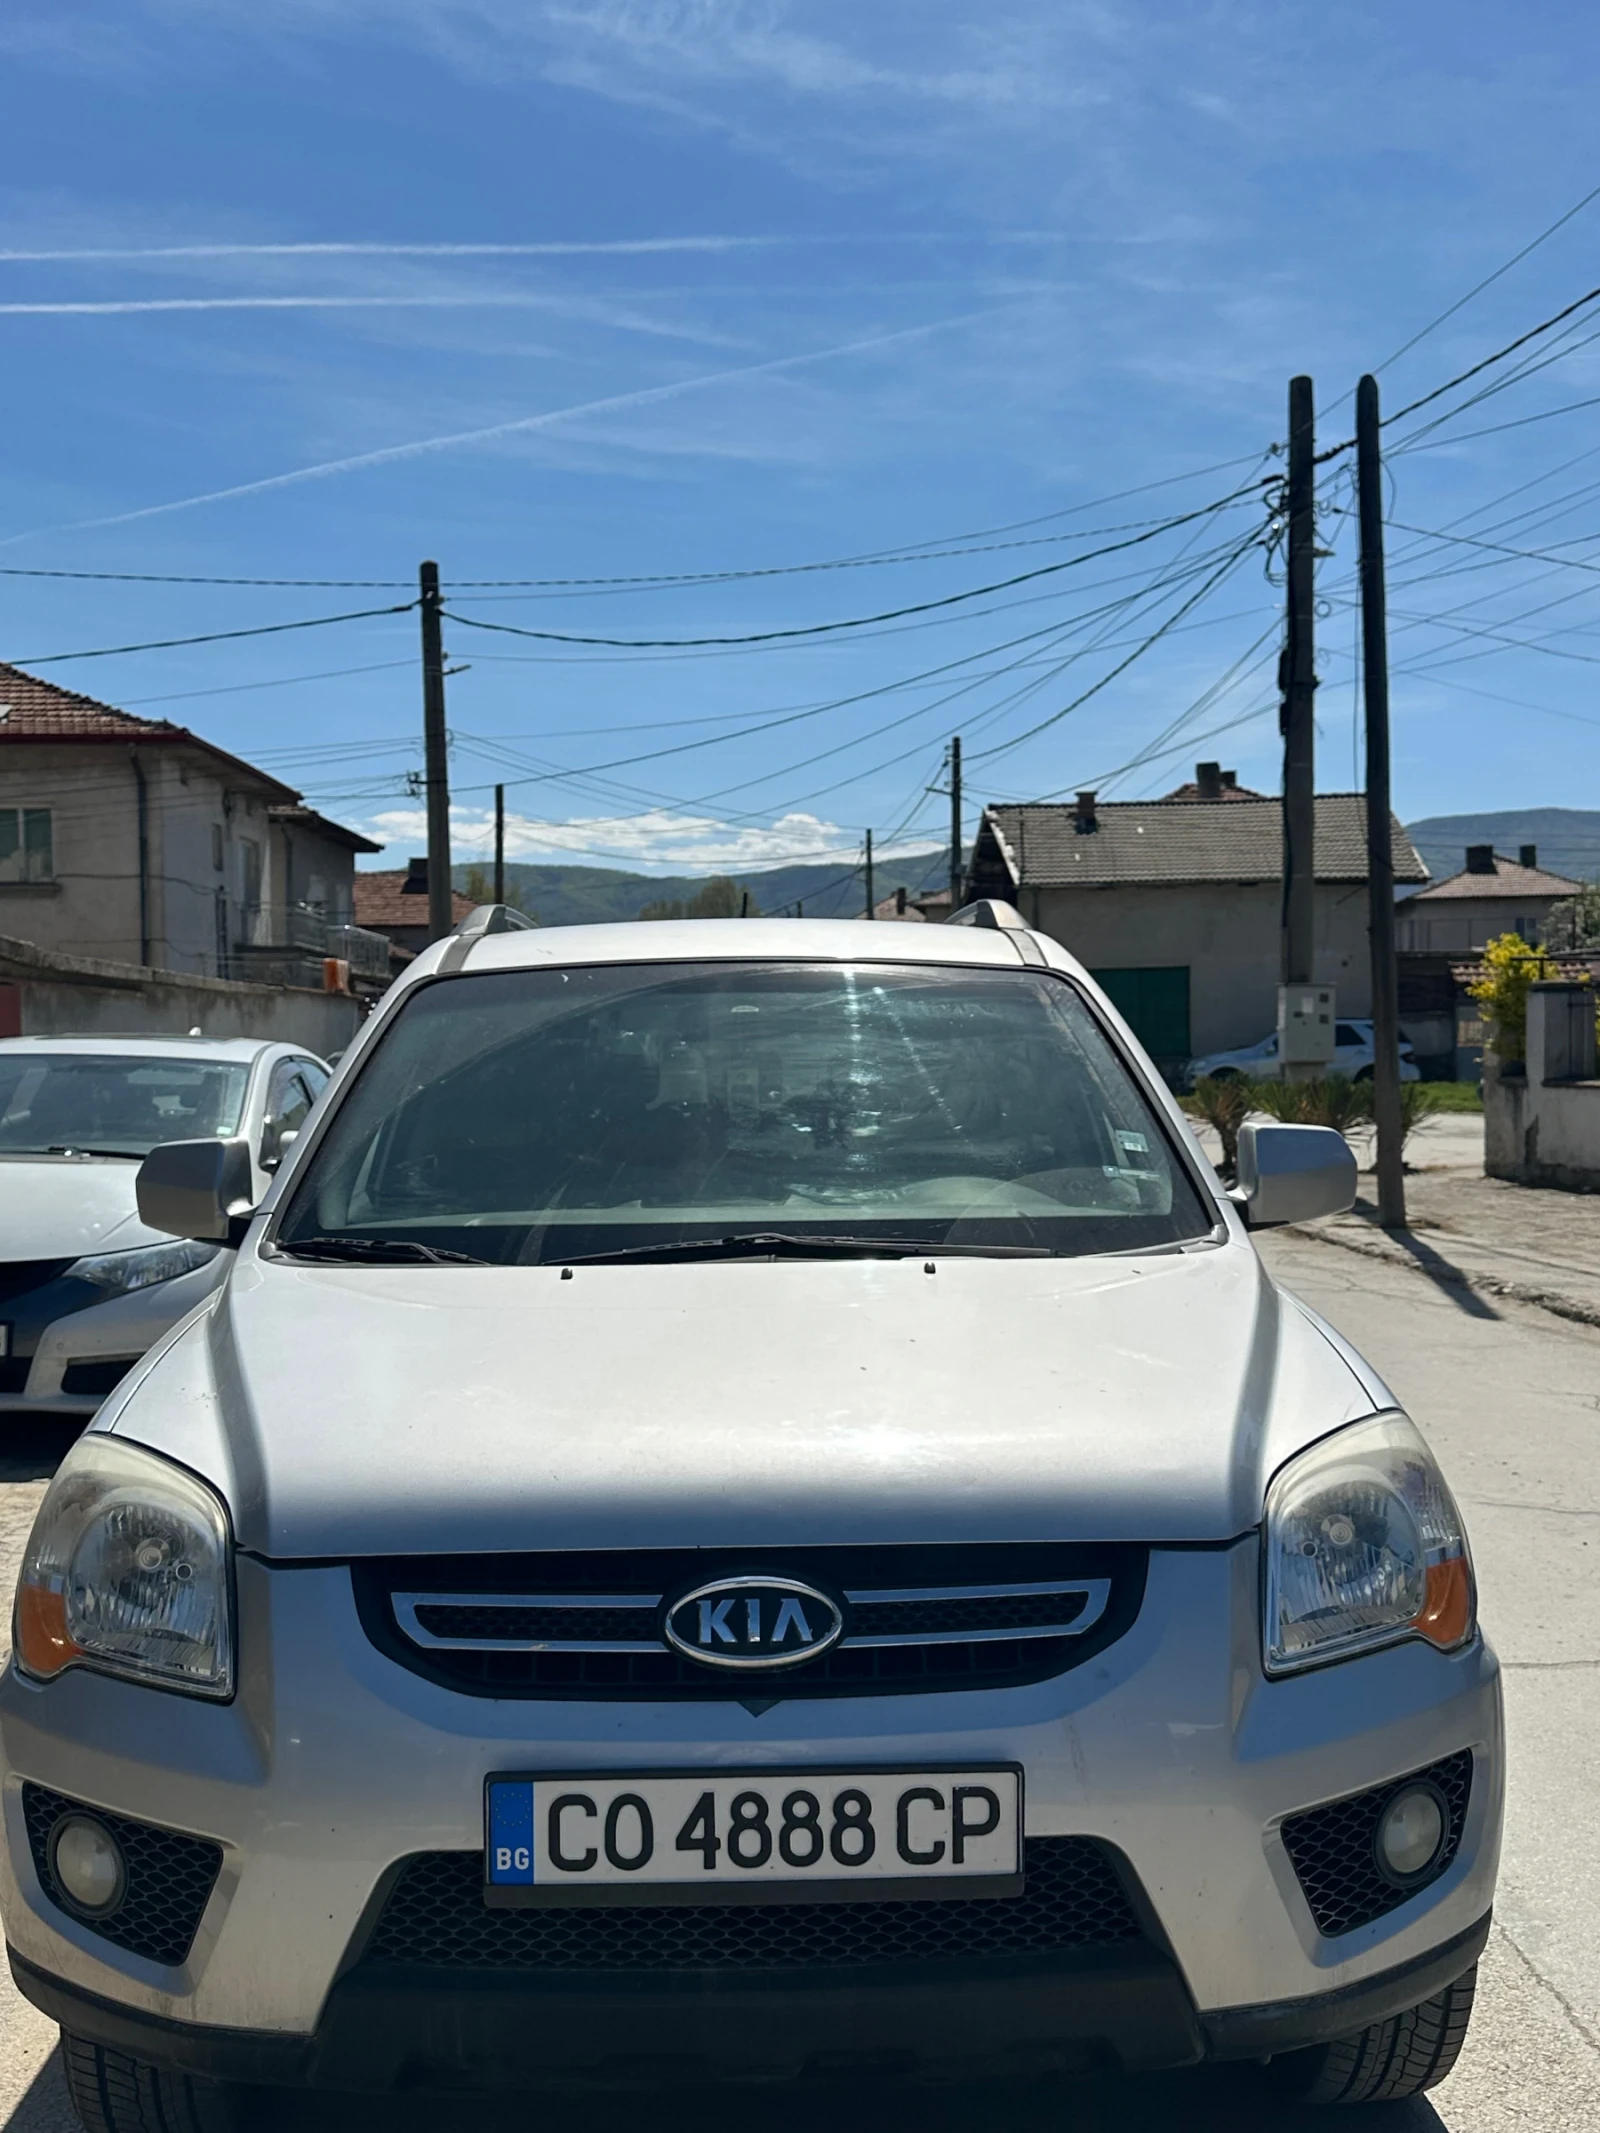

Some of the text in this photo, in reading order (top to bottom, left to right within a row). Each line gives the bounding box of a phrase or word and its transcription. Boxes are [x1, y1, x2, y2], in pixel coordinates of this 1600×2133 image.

[696, 1598, 813, 1644] KIA
[548, 1786, 1001, 1872] CO 4888 CP
[496, 1847, 530, 1870] BG
